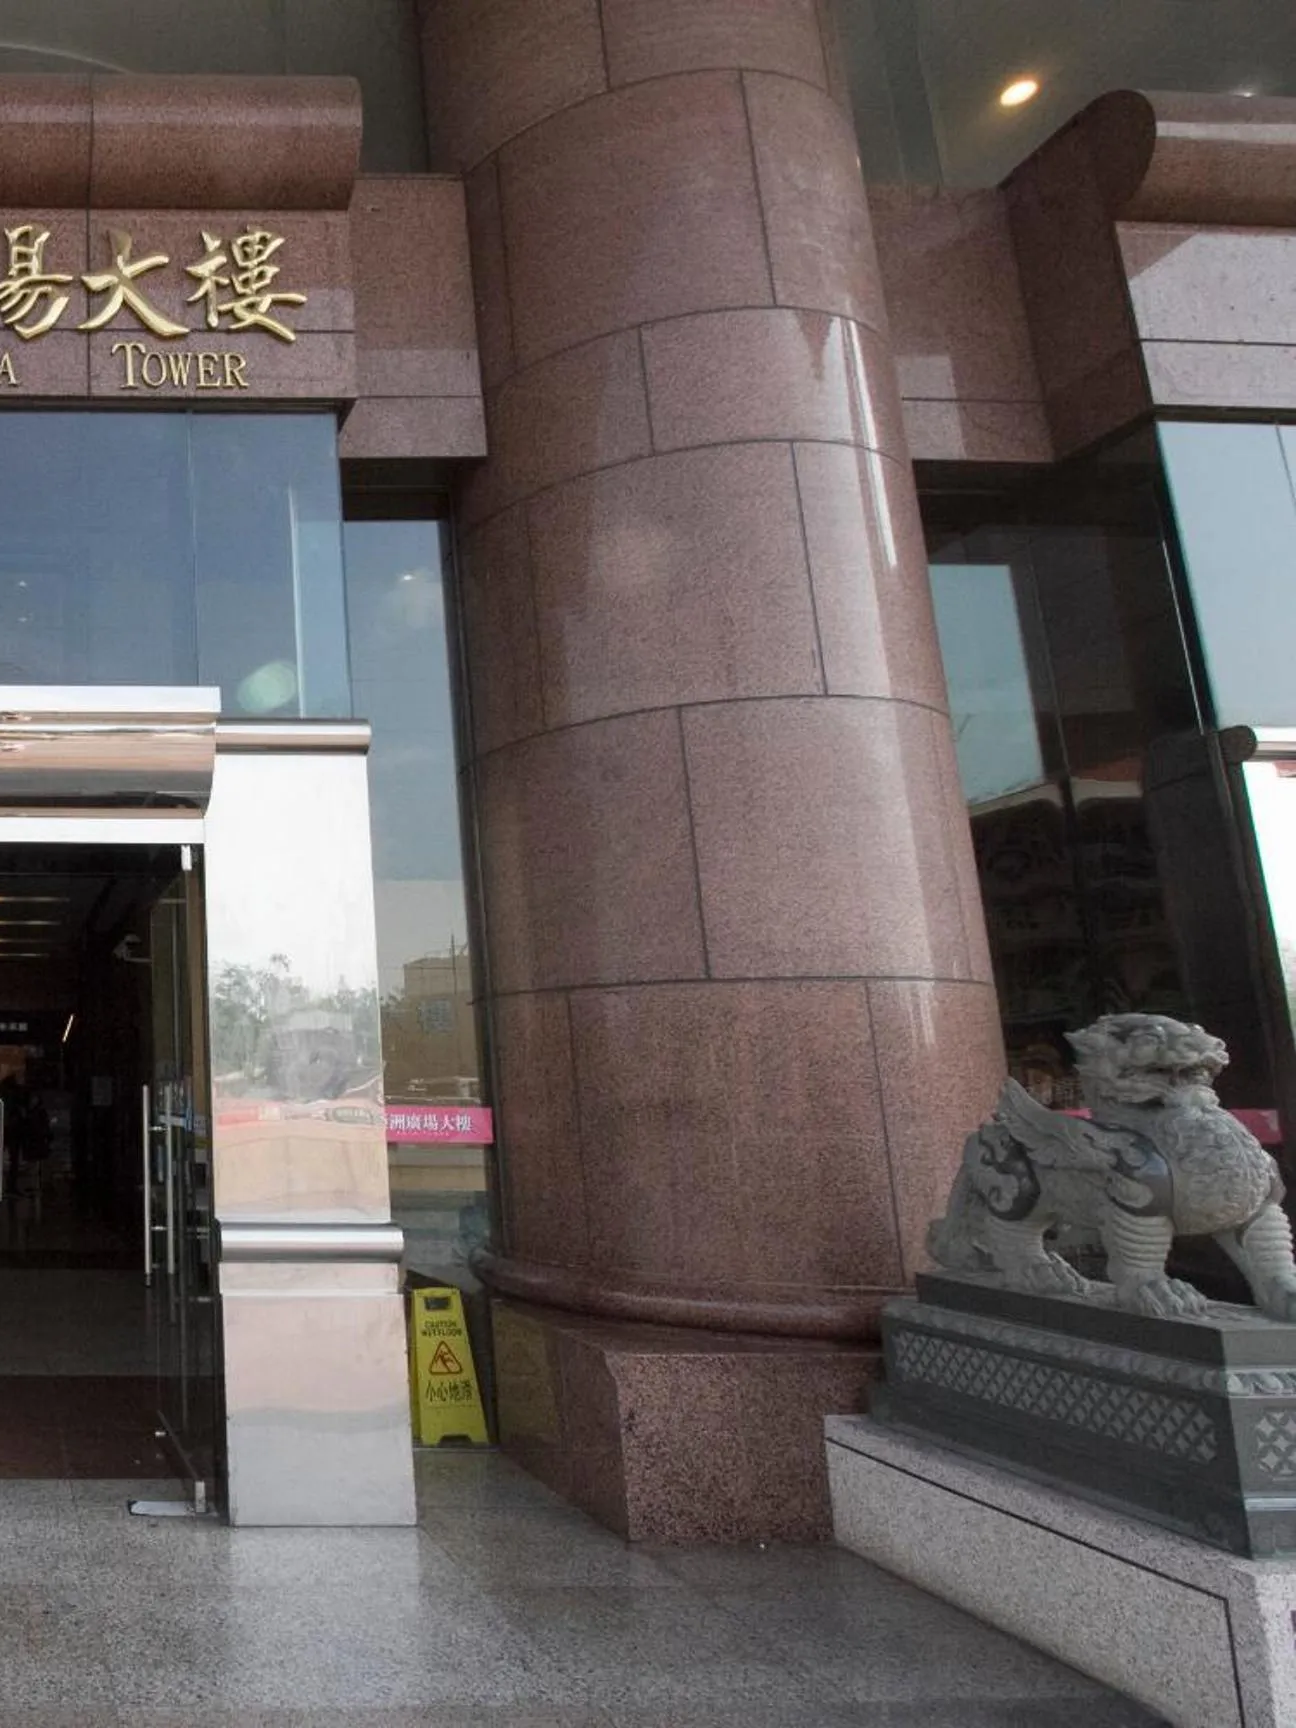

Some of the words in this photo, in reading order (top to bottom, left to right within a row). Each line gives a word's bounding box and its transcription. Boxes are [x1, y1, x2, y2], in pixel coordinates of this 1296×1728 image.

[386, 1112, 473, 1132] 洲廣場大樓
